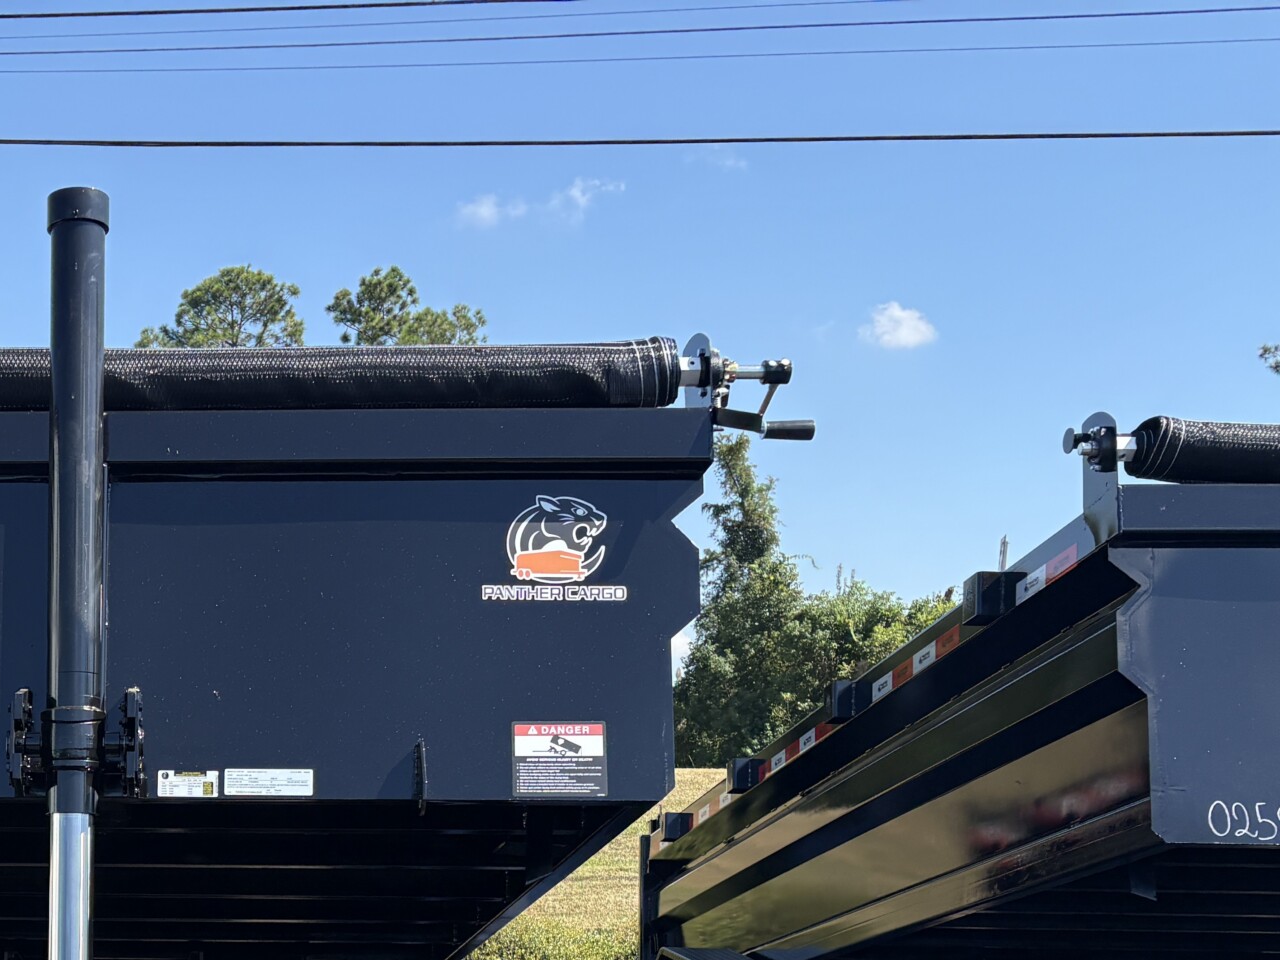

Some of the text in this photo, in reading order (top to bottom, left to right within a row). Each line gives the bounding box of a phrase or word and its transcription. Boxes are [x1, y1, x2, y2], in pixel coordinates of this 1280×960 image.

[481, 584, 628, 601] PANTHER CARGO
[540, 725, 590, 735] DANGER
[1207, 800, 1280, 841] 025
